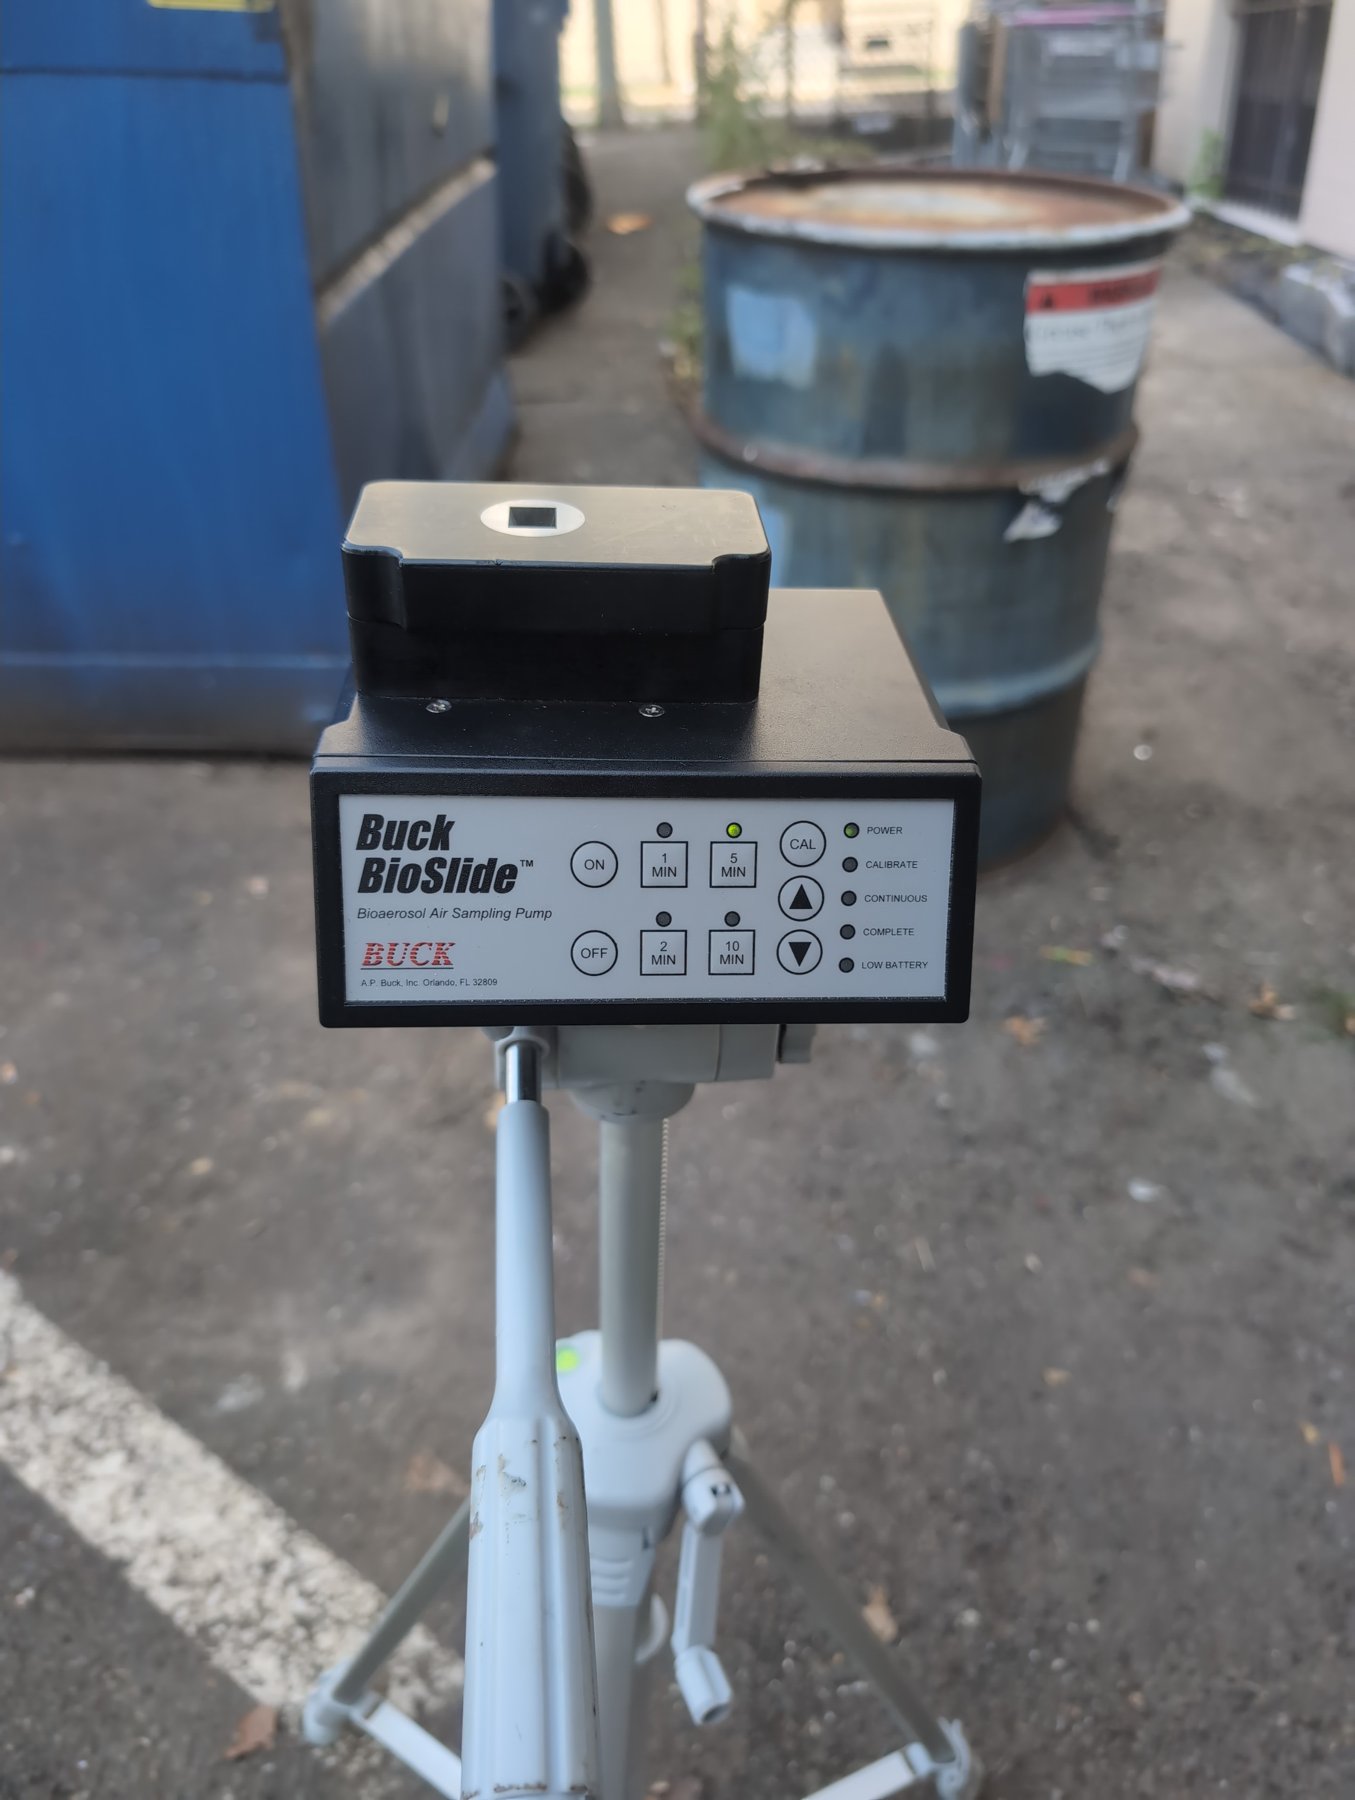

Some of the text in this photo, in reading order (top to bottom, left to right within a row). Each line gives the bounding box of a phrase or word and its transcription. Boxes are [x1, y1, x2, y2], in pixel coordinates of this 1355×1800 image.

[355, 813, 456, 852] Buck
[866, 826, 903, 835] POWER
[789, 838, 817, 850] CAL
[661, 852, 667, 864] 1
[729, 852, 738, 864] 5
[583, 858, 605, 871] ON
[865, 860, 919, 869] CALIBRATE
[652, 866, 677, 878] MIN
[721, 866, 746, 878] MIN
[864, 894, 928, 903] CONTINUOUS
[356, 907, 553, 922] Bioaerosol Air Sampling Pump
[862, 927, 915, 937] COMPLETE
[659, 940, 668, 952] 2
[725, 940, 740, 952] 10
[361, 941, 456, 967] BUCK
[580, 947, 609, 959] OFF
[719, 953, 745, 965] MIN
[651, 954, 676, 966] MIN
[861, 960, 929, 970] LOW BATTERY
[422, 978, 458, 988] Orlando,
[459, 978, 471, 987] FL
[472, 977, 498, 987] 32809
